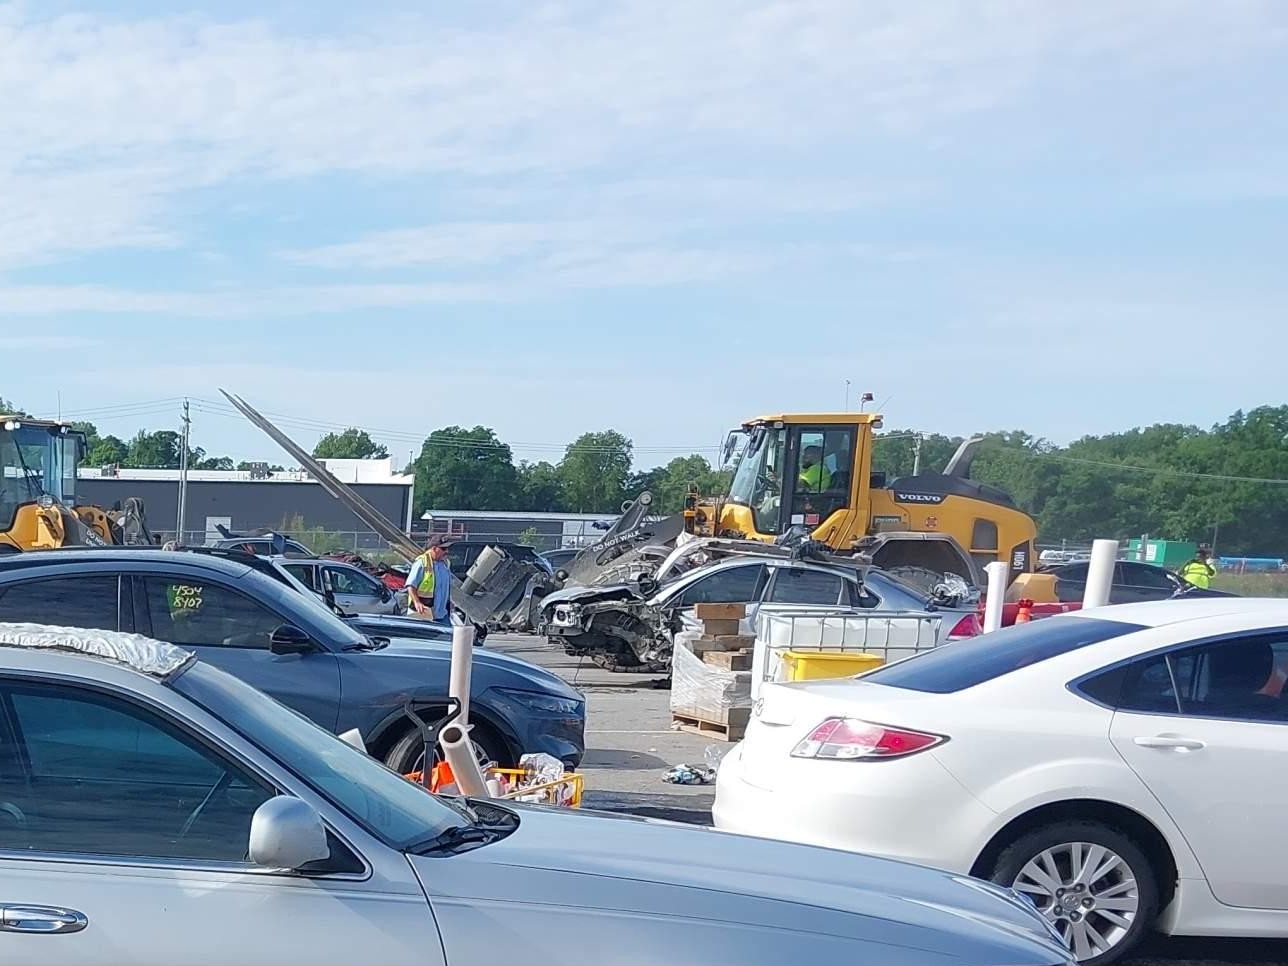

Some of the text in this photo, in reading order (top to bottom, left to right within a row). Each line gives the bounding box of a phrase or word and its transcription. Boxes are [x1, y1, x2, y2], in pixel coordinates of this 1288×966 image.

[604, 535, 618, 548] NOT
[620, 530, 640, 541] WALK
[172, 584, 203, 596] 4504
[173, 596, 202, 608] 8407
